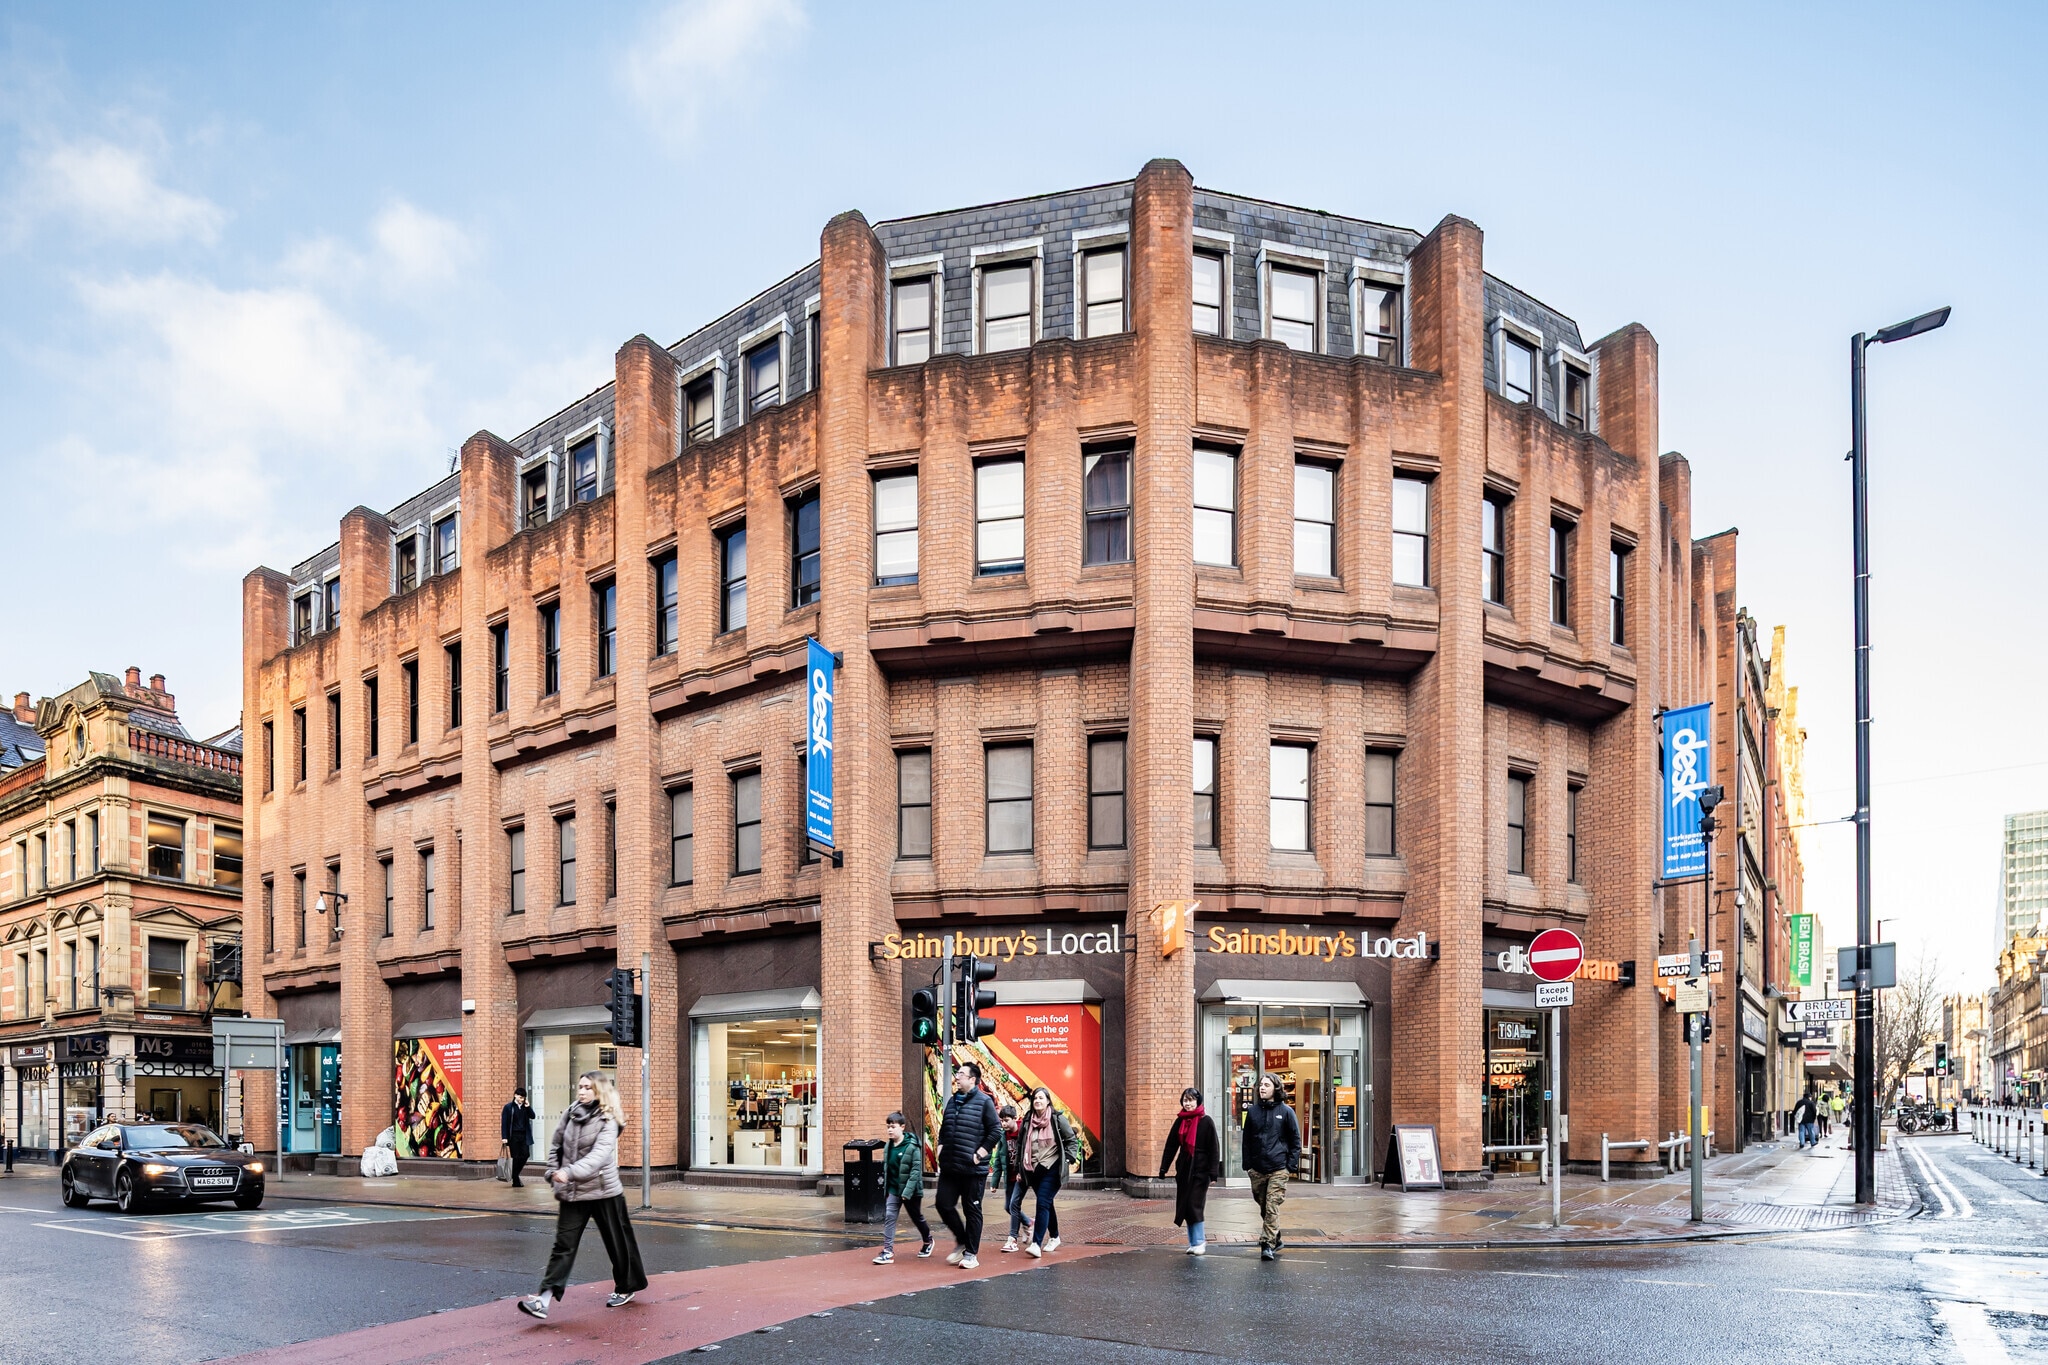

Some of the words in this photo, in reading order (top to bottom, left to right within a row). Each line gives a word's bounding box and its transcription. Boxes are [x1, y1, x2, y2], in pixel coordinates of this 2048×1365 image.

[813, 668, 832, 759] desk
[1672, 728, 1708, 808] desk
[1799, 917, 1810, 939] BEM
[883, 929, 1037, 962] Sainbury's
[1046, 924, 1120, 954] Local
[1208, 926, 1356, 963] Sainsbury's
[1361, 931, 1428, 959] Local
[1798, 941, 1810, 978] BRASIL
[1540, 985, 1569, 995] Except
[1541, 995, 1568, 1005] cycles
[1805, 1001, 1846, 1011] BRIDGE
[1025, 1015, 1048, 1023] Fresh
[1050, 1014, 1069, 1023] food
[1805, 1010, 1846, 1020] STREET
[1043, 1025, 1057, 1033] the
[1058, 1026, 1069, 1035] go
[1499, 1023, 1519, 1038] TSA
[72, 1037, 107, 1055] M3
[139, 1037, 173, 1057] M3
[791, 1067, 803, 1077] Bee
